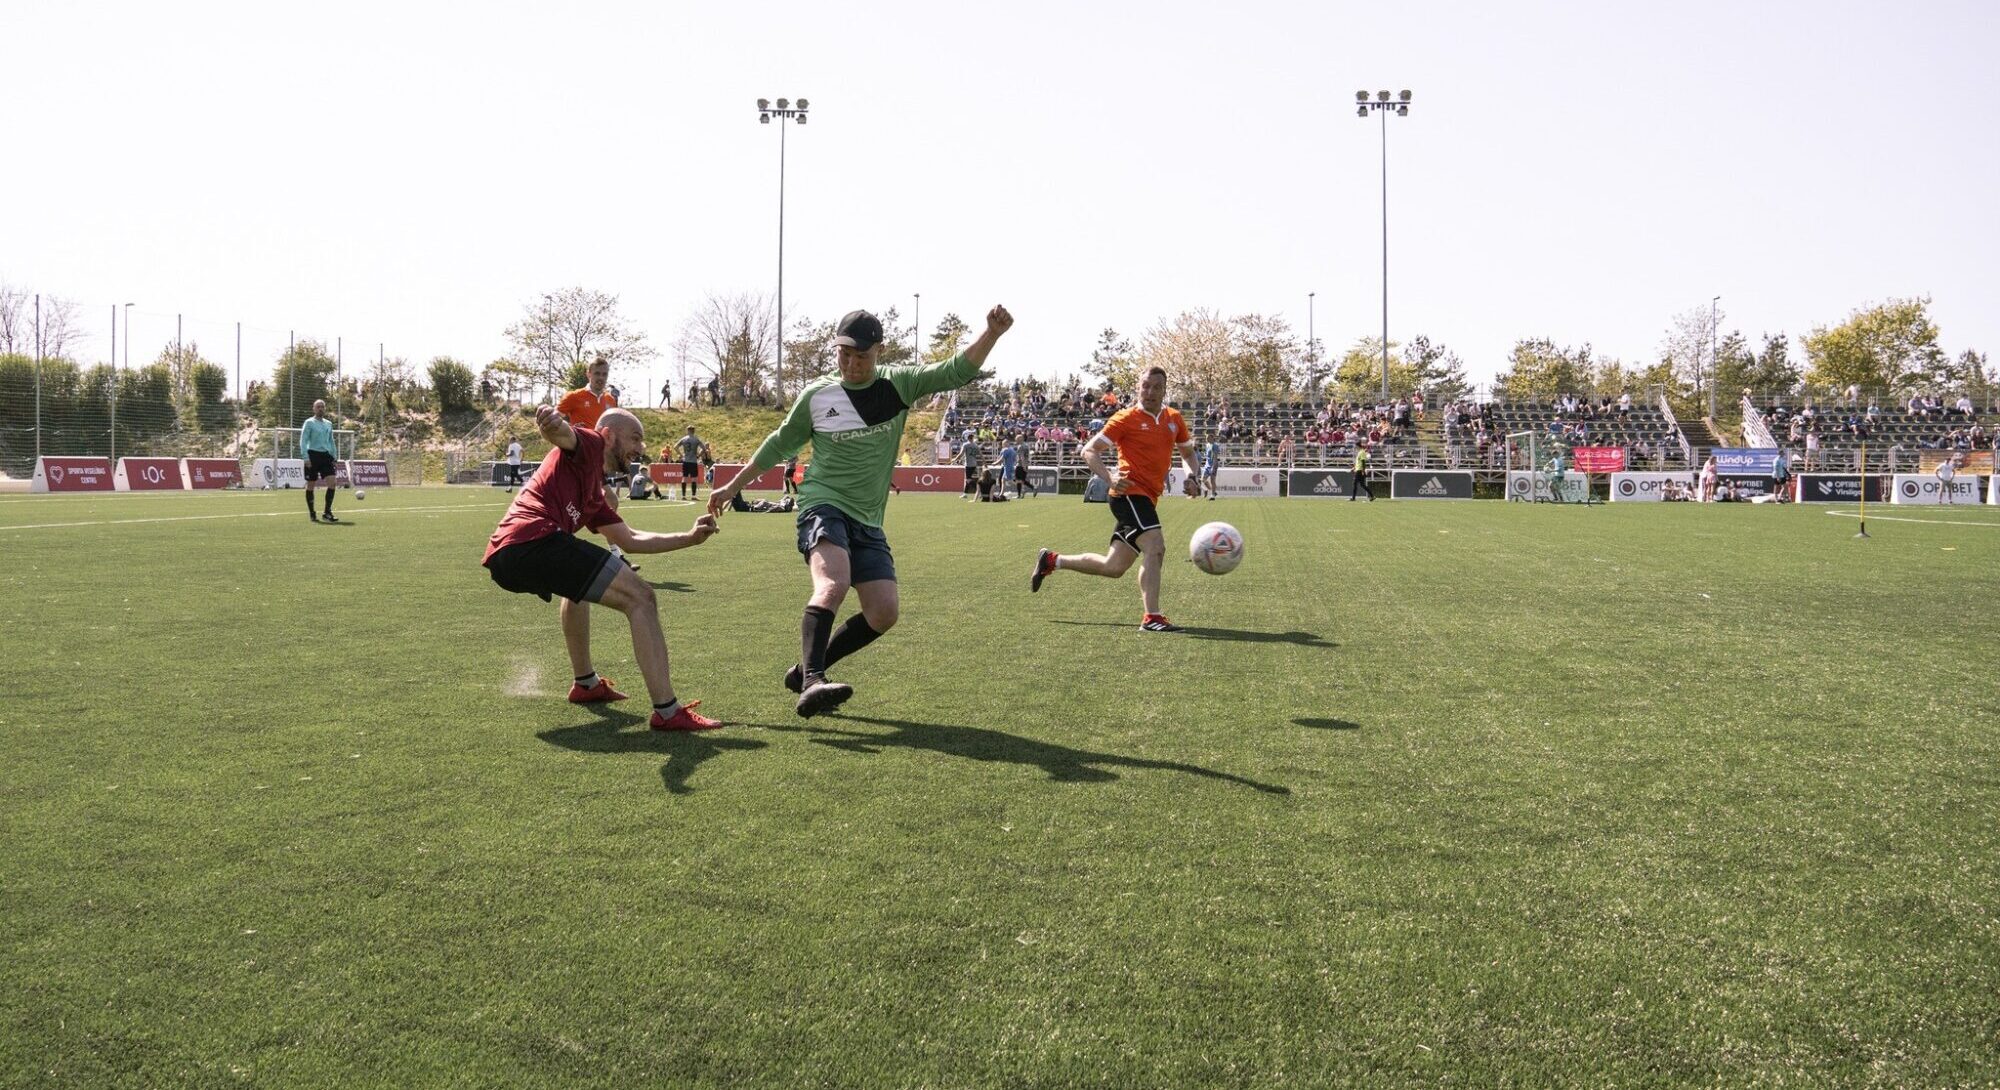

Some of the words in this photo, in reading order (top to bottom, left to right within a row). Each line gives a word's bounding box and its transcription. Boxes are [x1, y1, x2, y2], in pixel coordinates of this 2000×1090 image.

[841, 424, 891, 440] CALJAN
[915, 473, 940, 486] LOC
[1313, 485, 1342, 494] adidas
[1418, 487, 1447, 495] adidas
